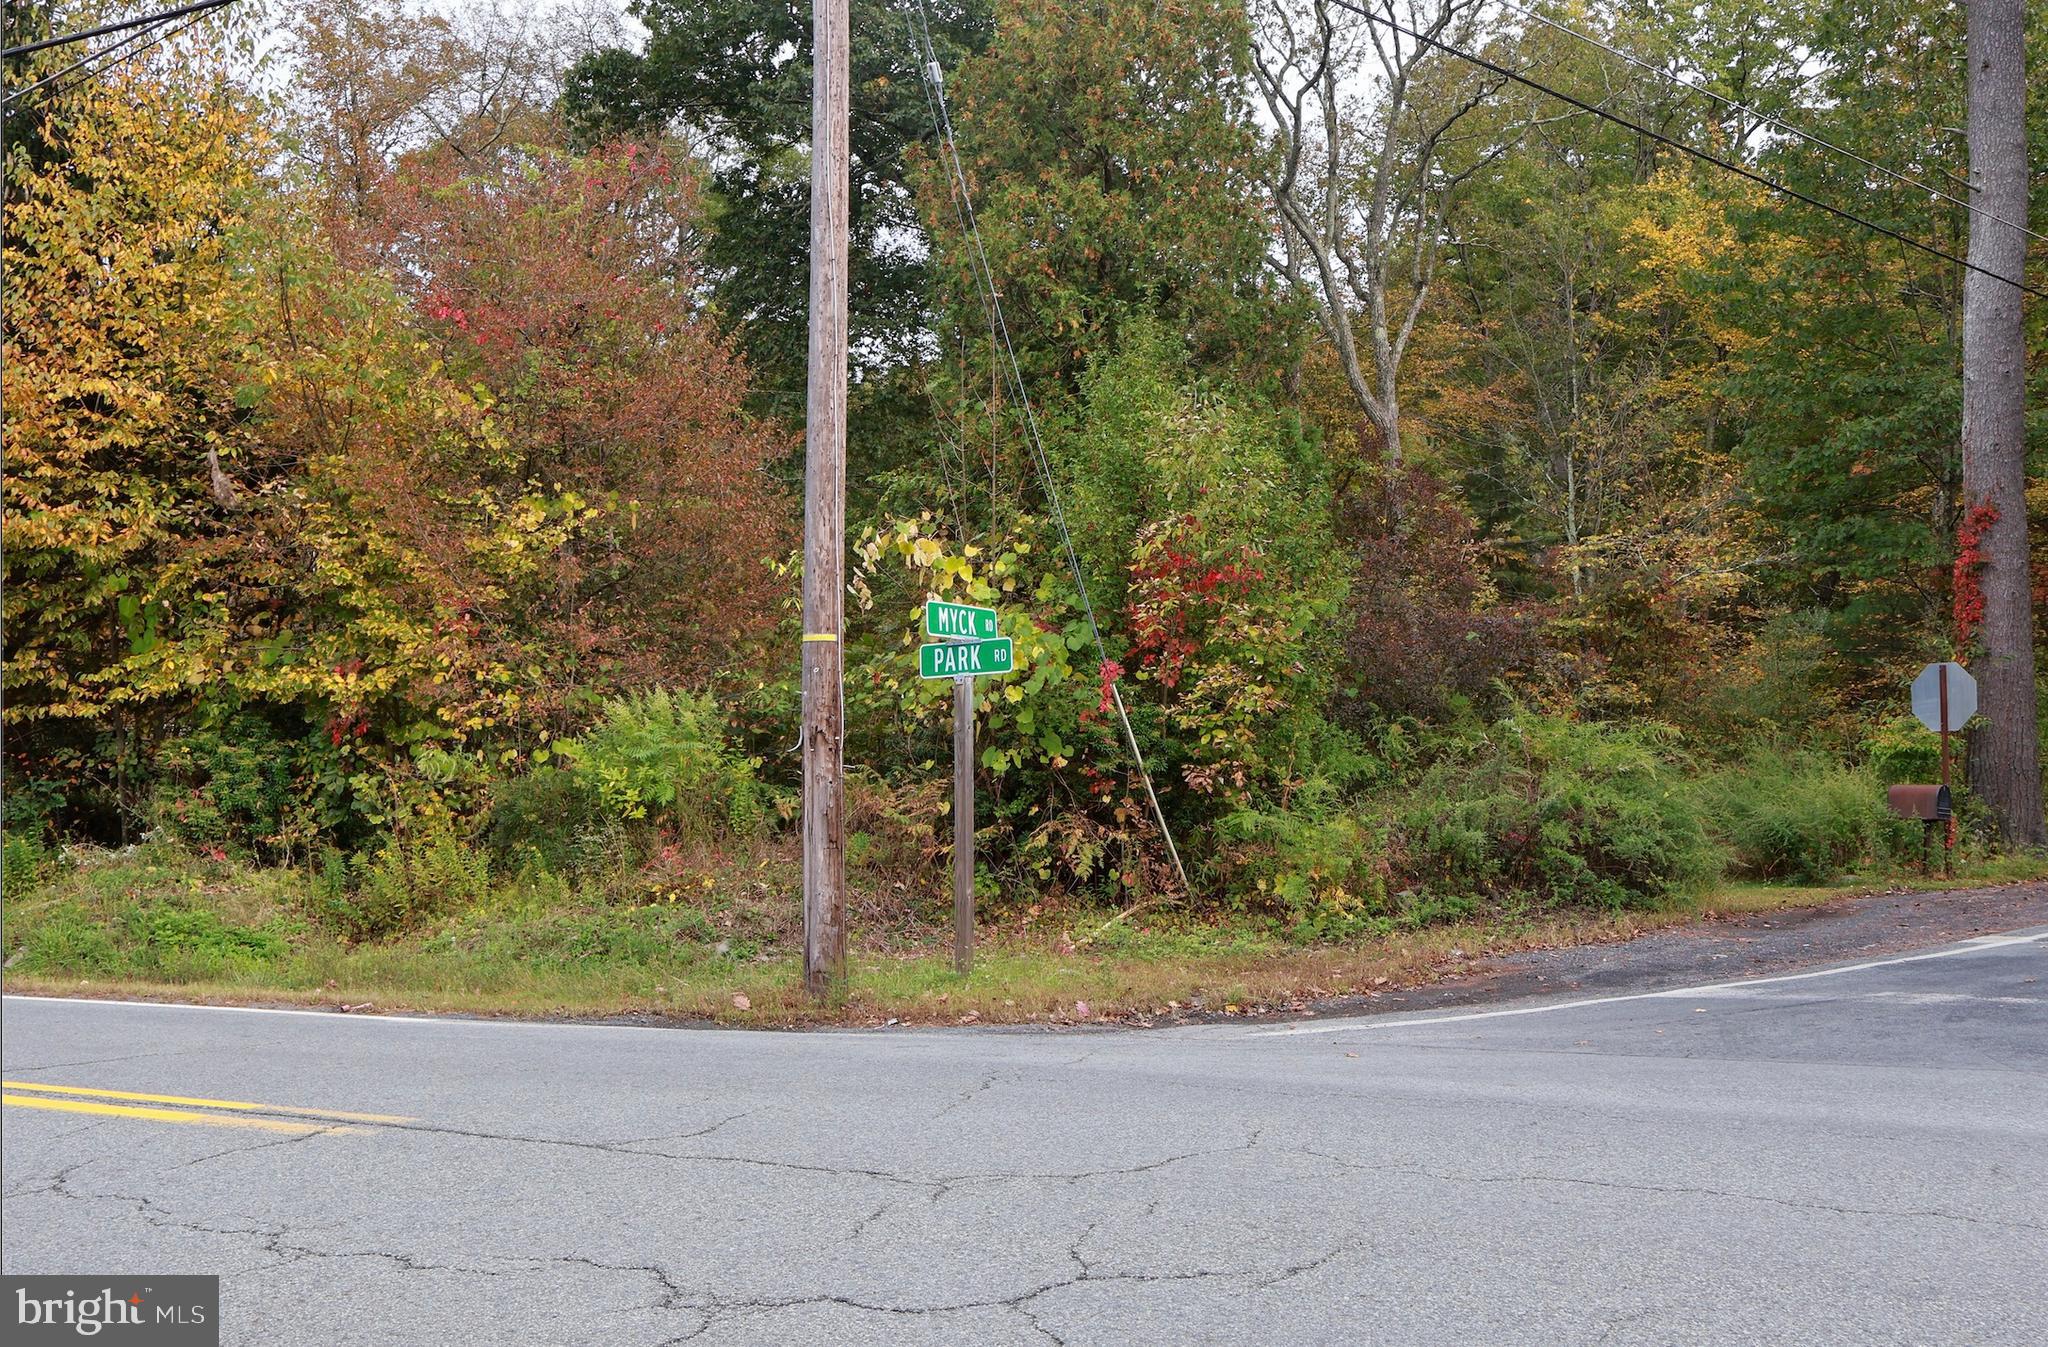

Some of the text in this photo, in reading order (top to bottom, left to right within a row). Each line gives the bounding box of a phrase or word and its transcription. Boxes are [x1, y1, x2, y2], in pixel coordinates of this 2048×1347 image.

[938, 606, 994, 636] MYCK RD
[934, 645, 1007, 673] PARK RD
